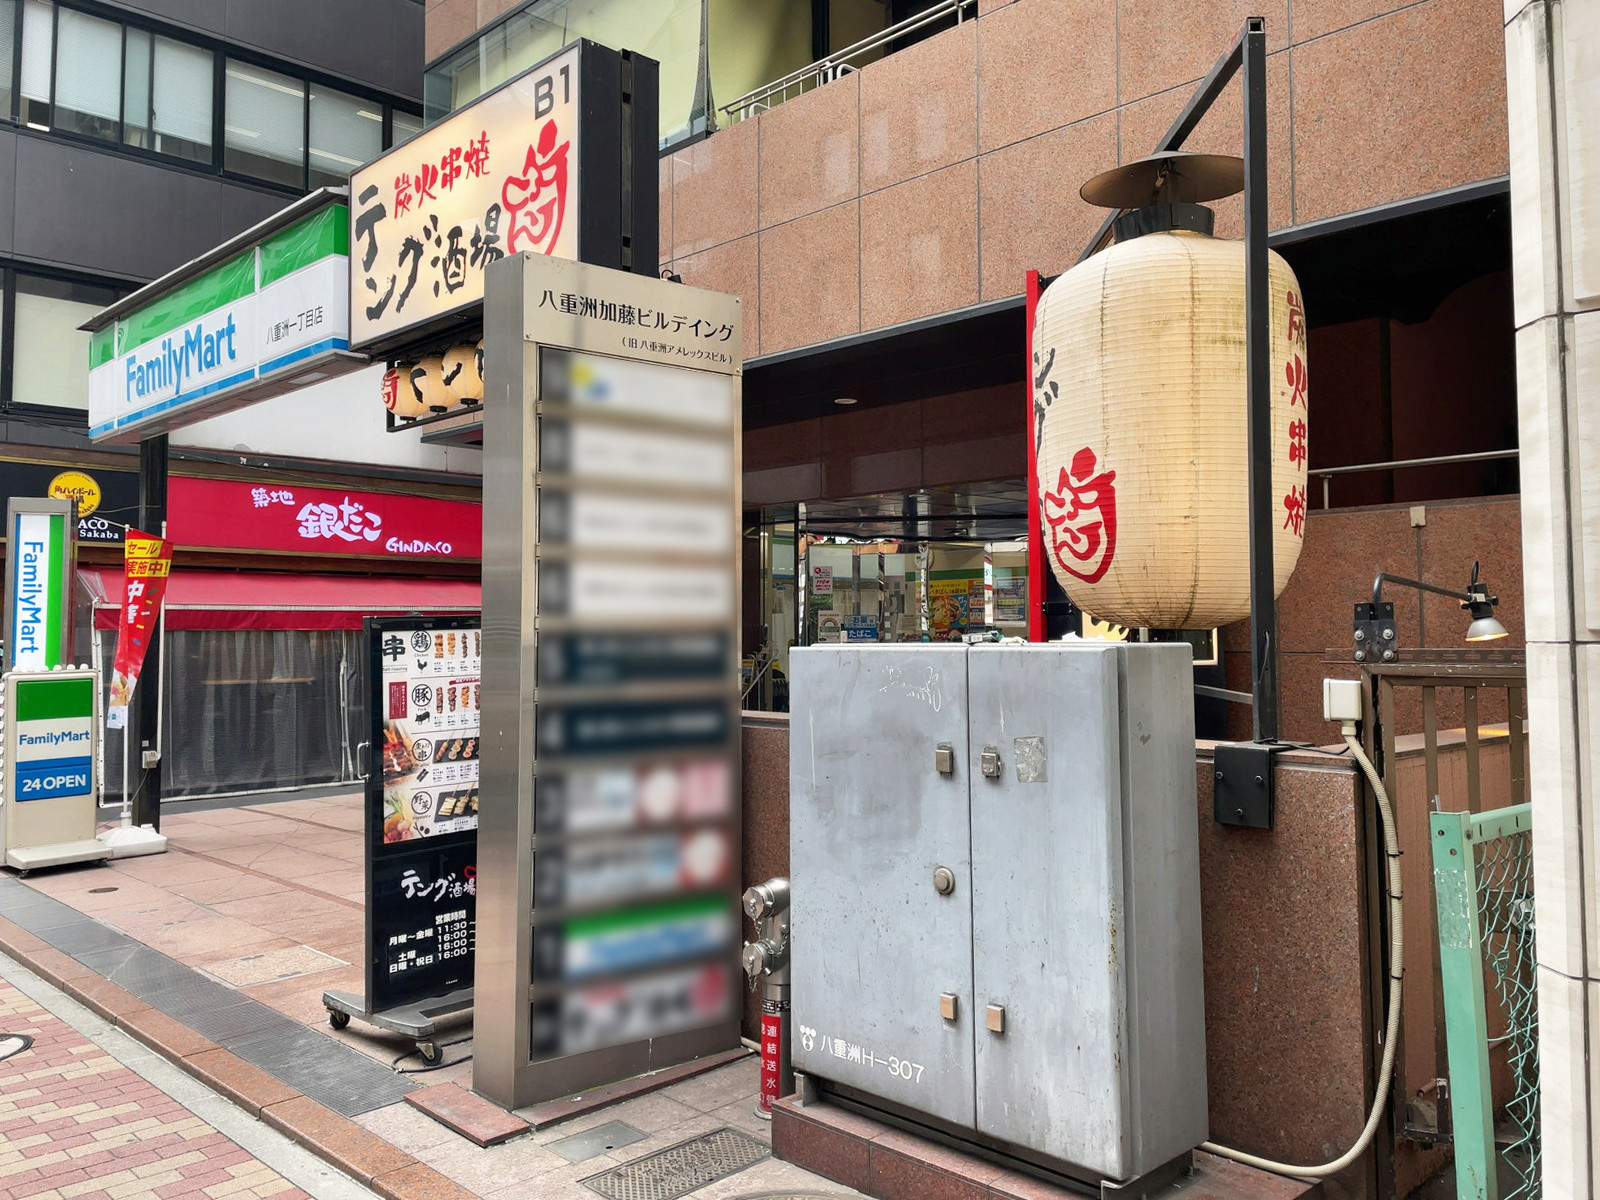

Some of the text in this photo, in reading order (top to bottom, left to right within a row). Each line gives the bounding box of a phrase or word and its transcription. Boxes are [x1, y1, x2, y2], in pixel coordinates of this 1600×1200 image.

[534, 63, 570, 120] B1
[394, 130, 491, 219] 炭火串焼
[355, 184, 505, 321] テング酒場
[266, 305, 323, 345] 八重洲一丁目店
[126, 312, 237, 401] FamilyMart
[251, 487, 295, 508] 築地
[296, 496, 382, 542] 銀だこ
[80, 529, 119, 539] Sakaba
[127, 541, 158, 555] セール
[385, 537, 452, 554] GINDACO
[18, 541, 44, 654] FamilyMart
[413, 632, 429, 650] 鶏
[848, 629, 872, 638] たばこ
[382, 634, 406, 662] 串
[414, 685, 431, 703] 豚
[19, 730, 90, 746] FamilyMart
[400, 869, 476, 902] テング酒場
[435, 909, 466, 925] 営業時間
[398, 950, 416, 962] 土曜
